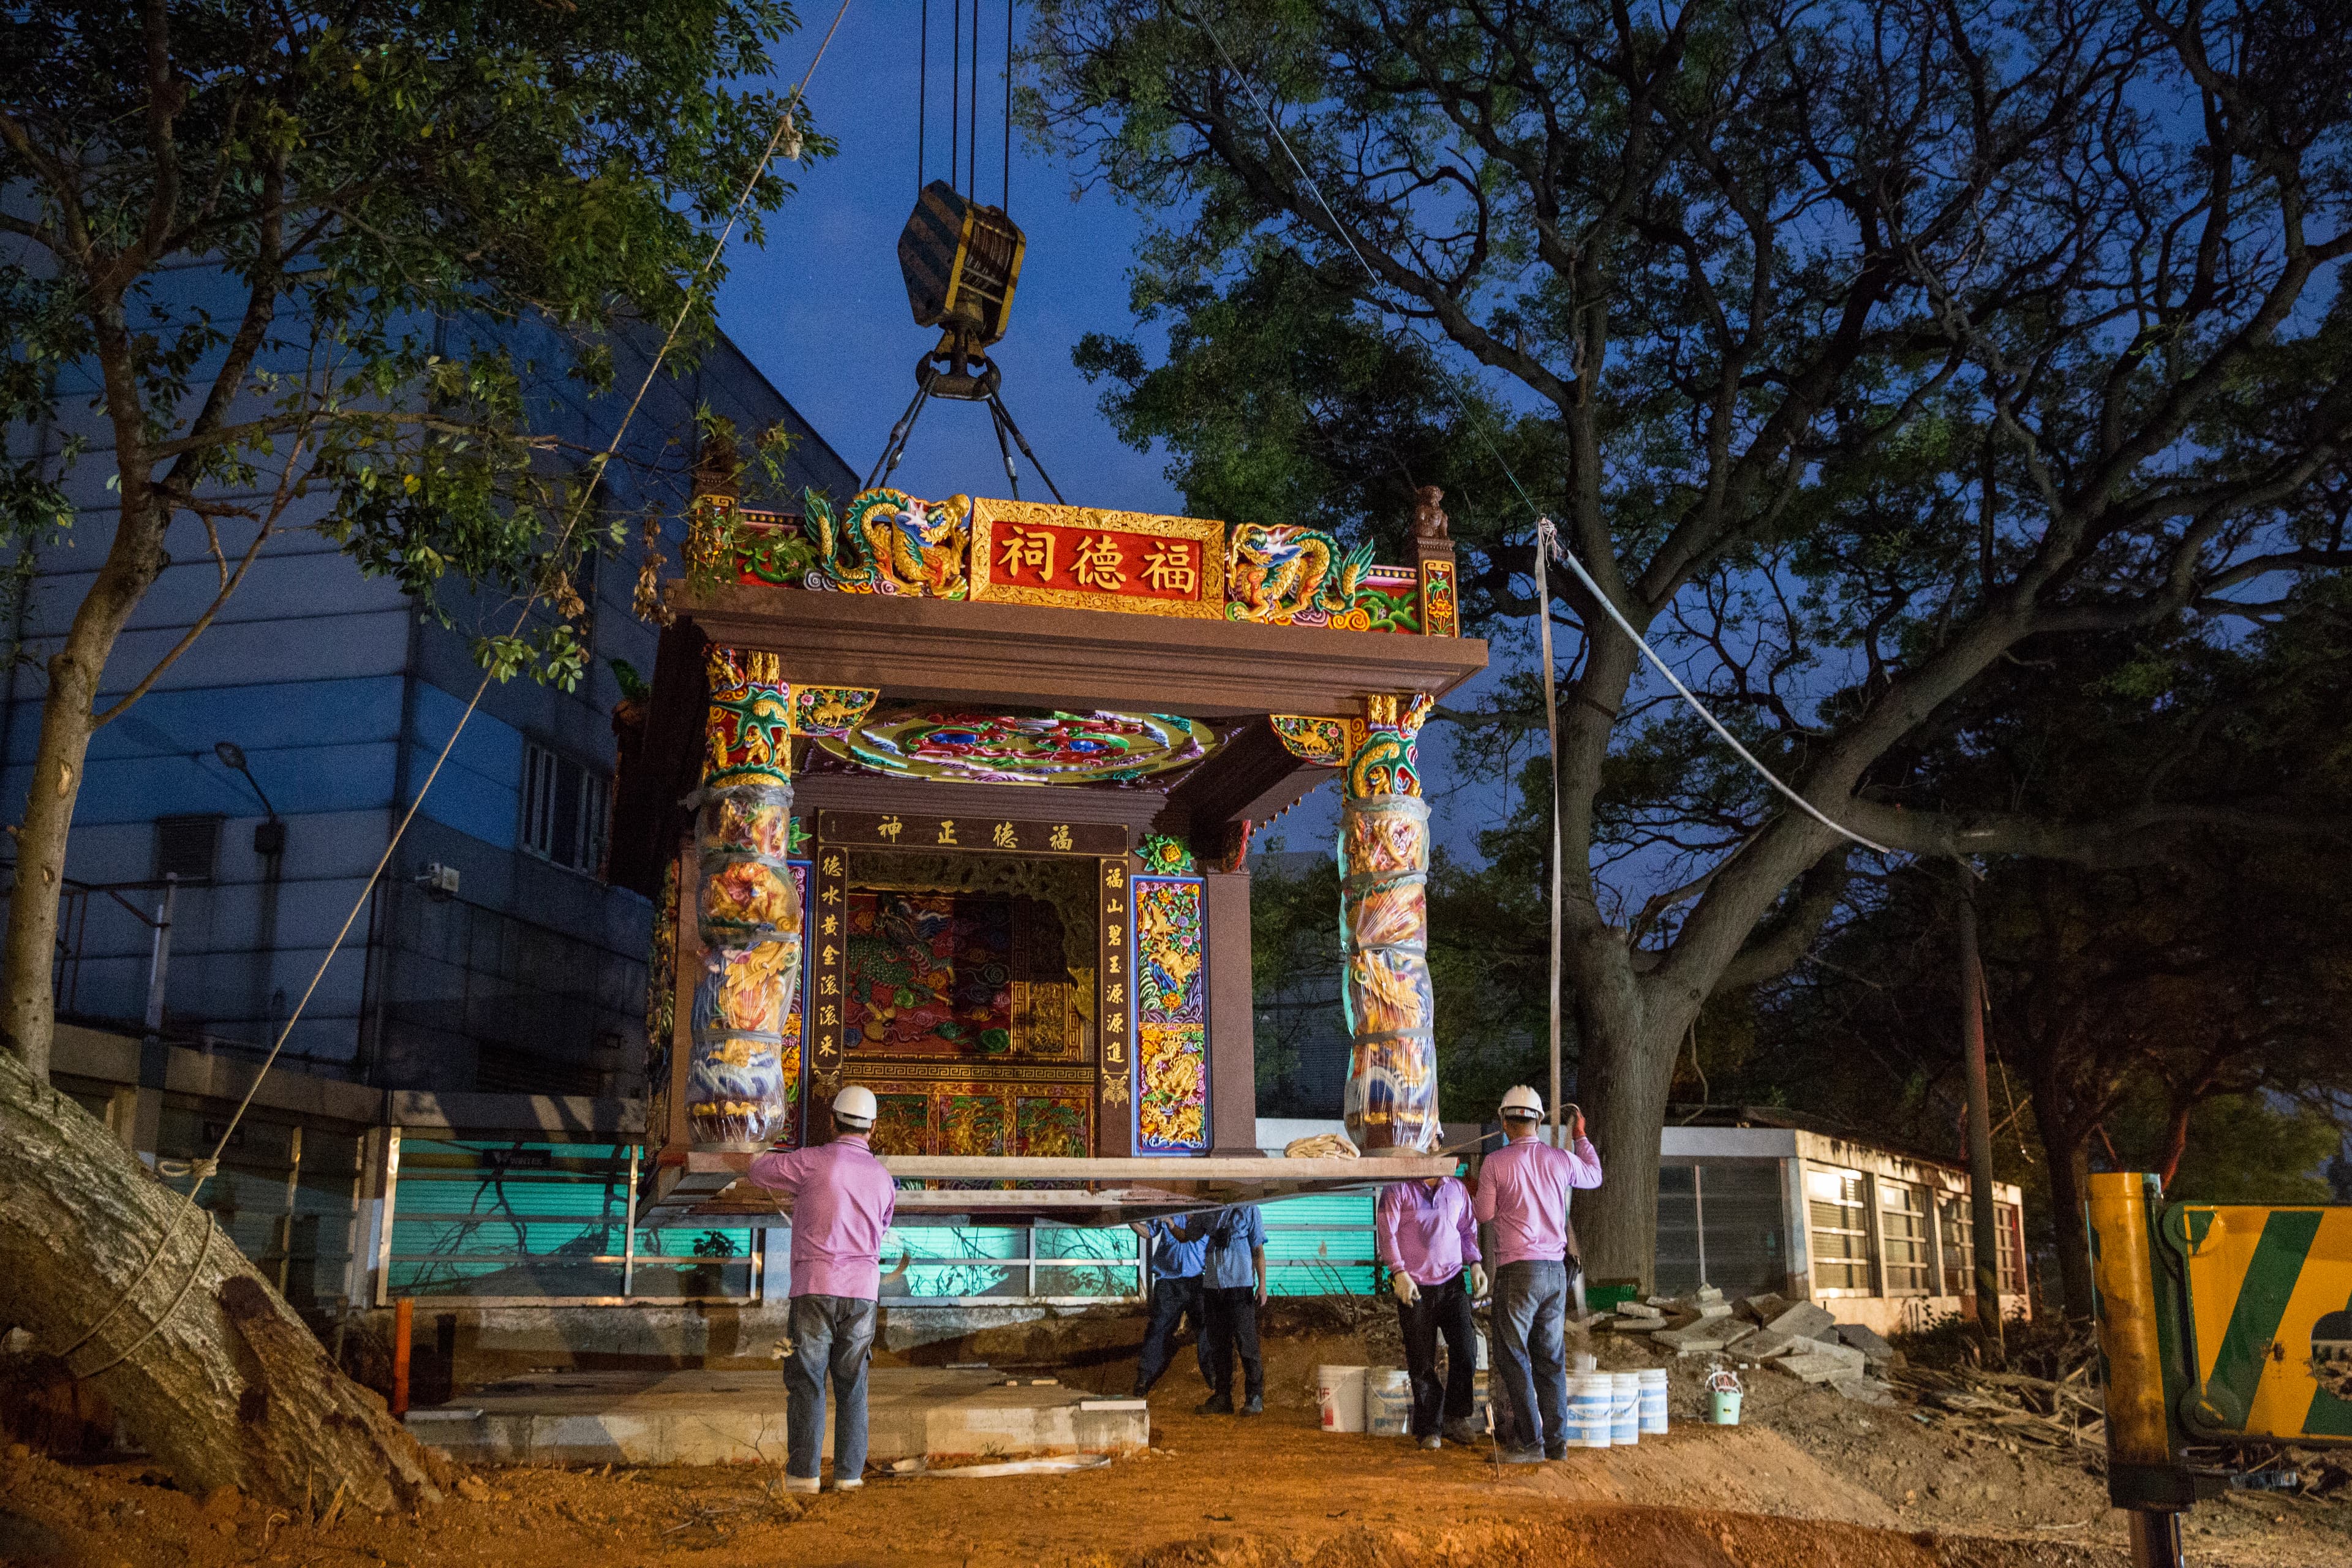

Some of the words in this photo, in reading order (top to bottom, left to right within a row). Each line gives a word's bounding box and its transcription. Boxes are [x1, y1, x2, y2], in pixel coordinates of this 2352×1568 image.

[998, 526, 1196, 593] 福德祠
[878, 816, 1073, 851] 福德正神
